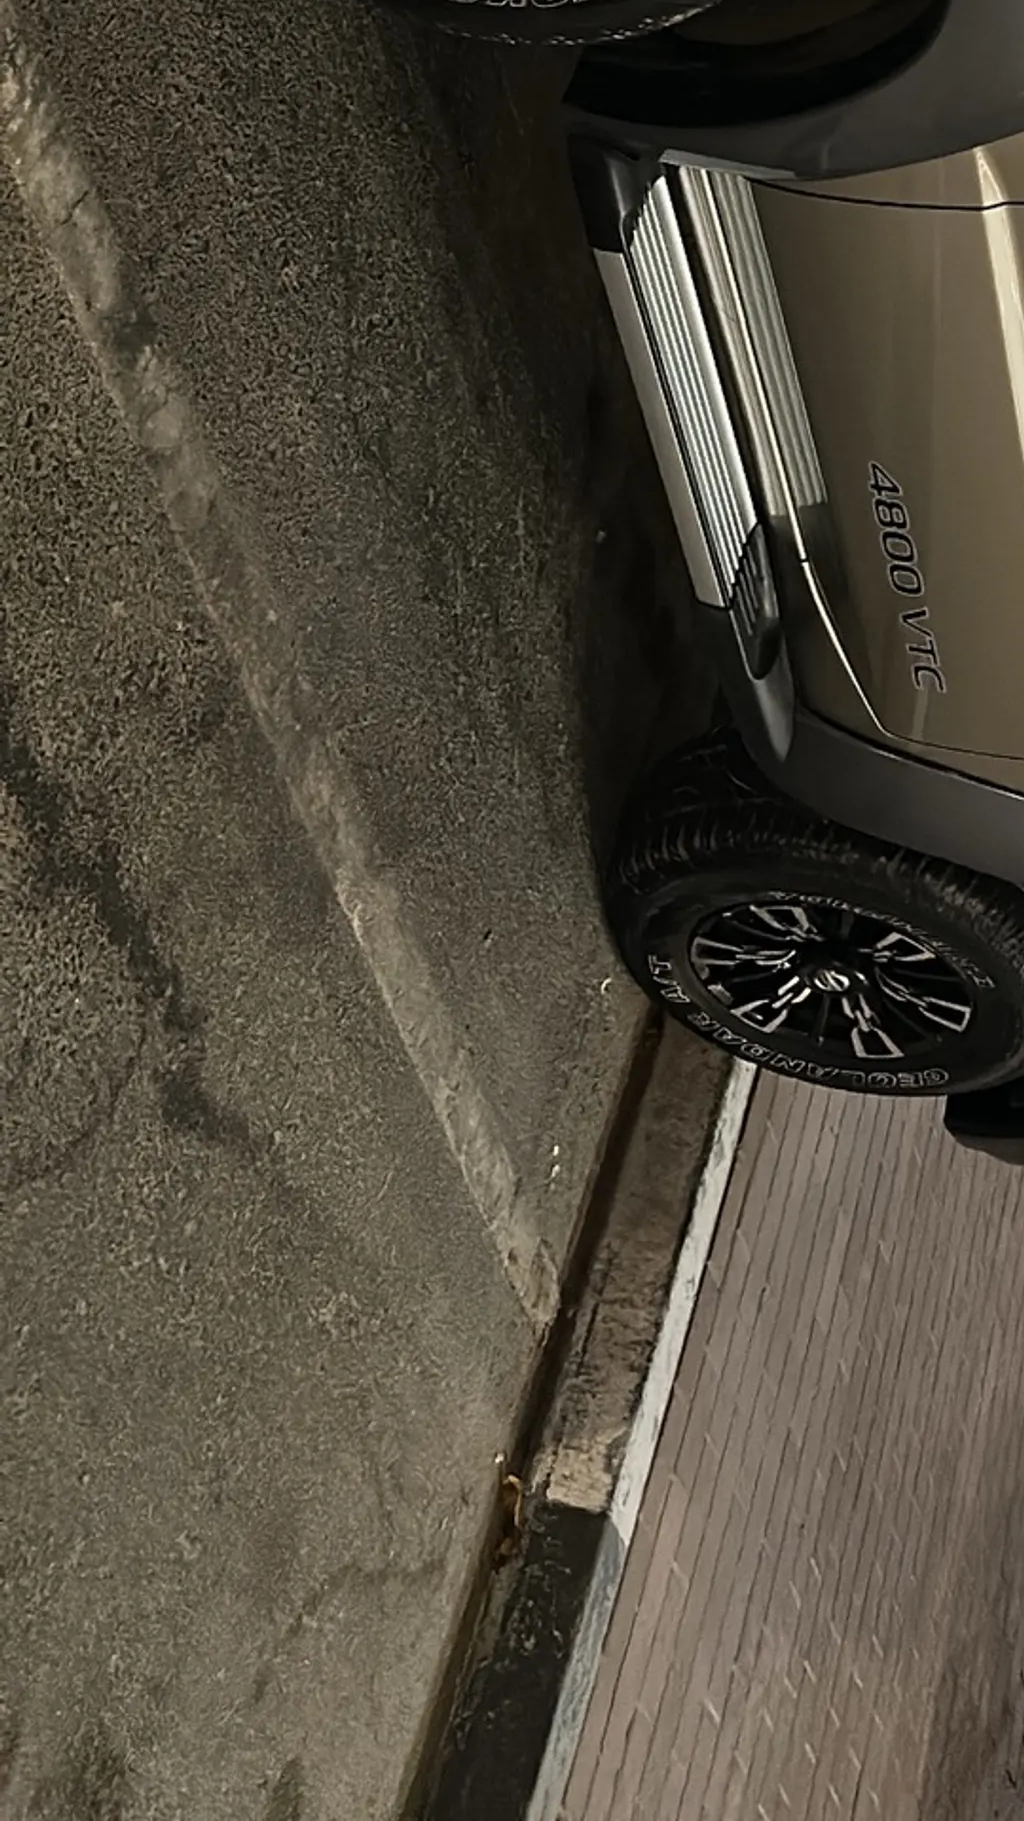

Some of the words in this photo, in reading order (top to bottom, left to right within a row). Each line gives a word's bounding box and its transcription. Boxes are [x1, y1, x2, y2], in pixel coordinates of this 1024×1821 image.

[868, 460, 925, 598] 4800
[899, 606, 947, 694] VTC
[648, 953, 691, 1004] A/T
[687, 1010, 950, 1089] GEOLANDAR
